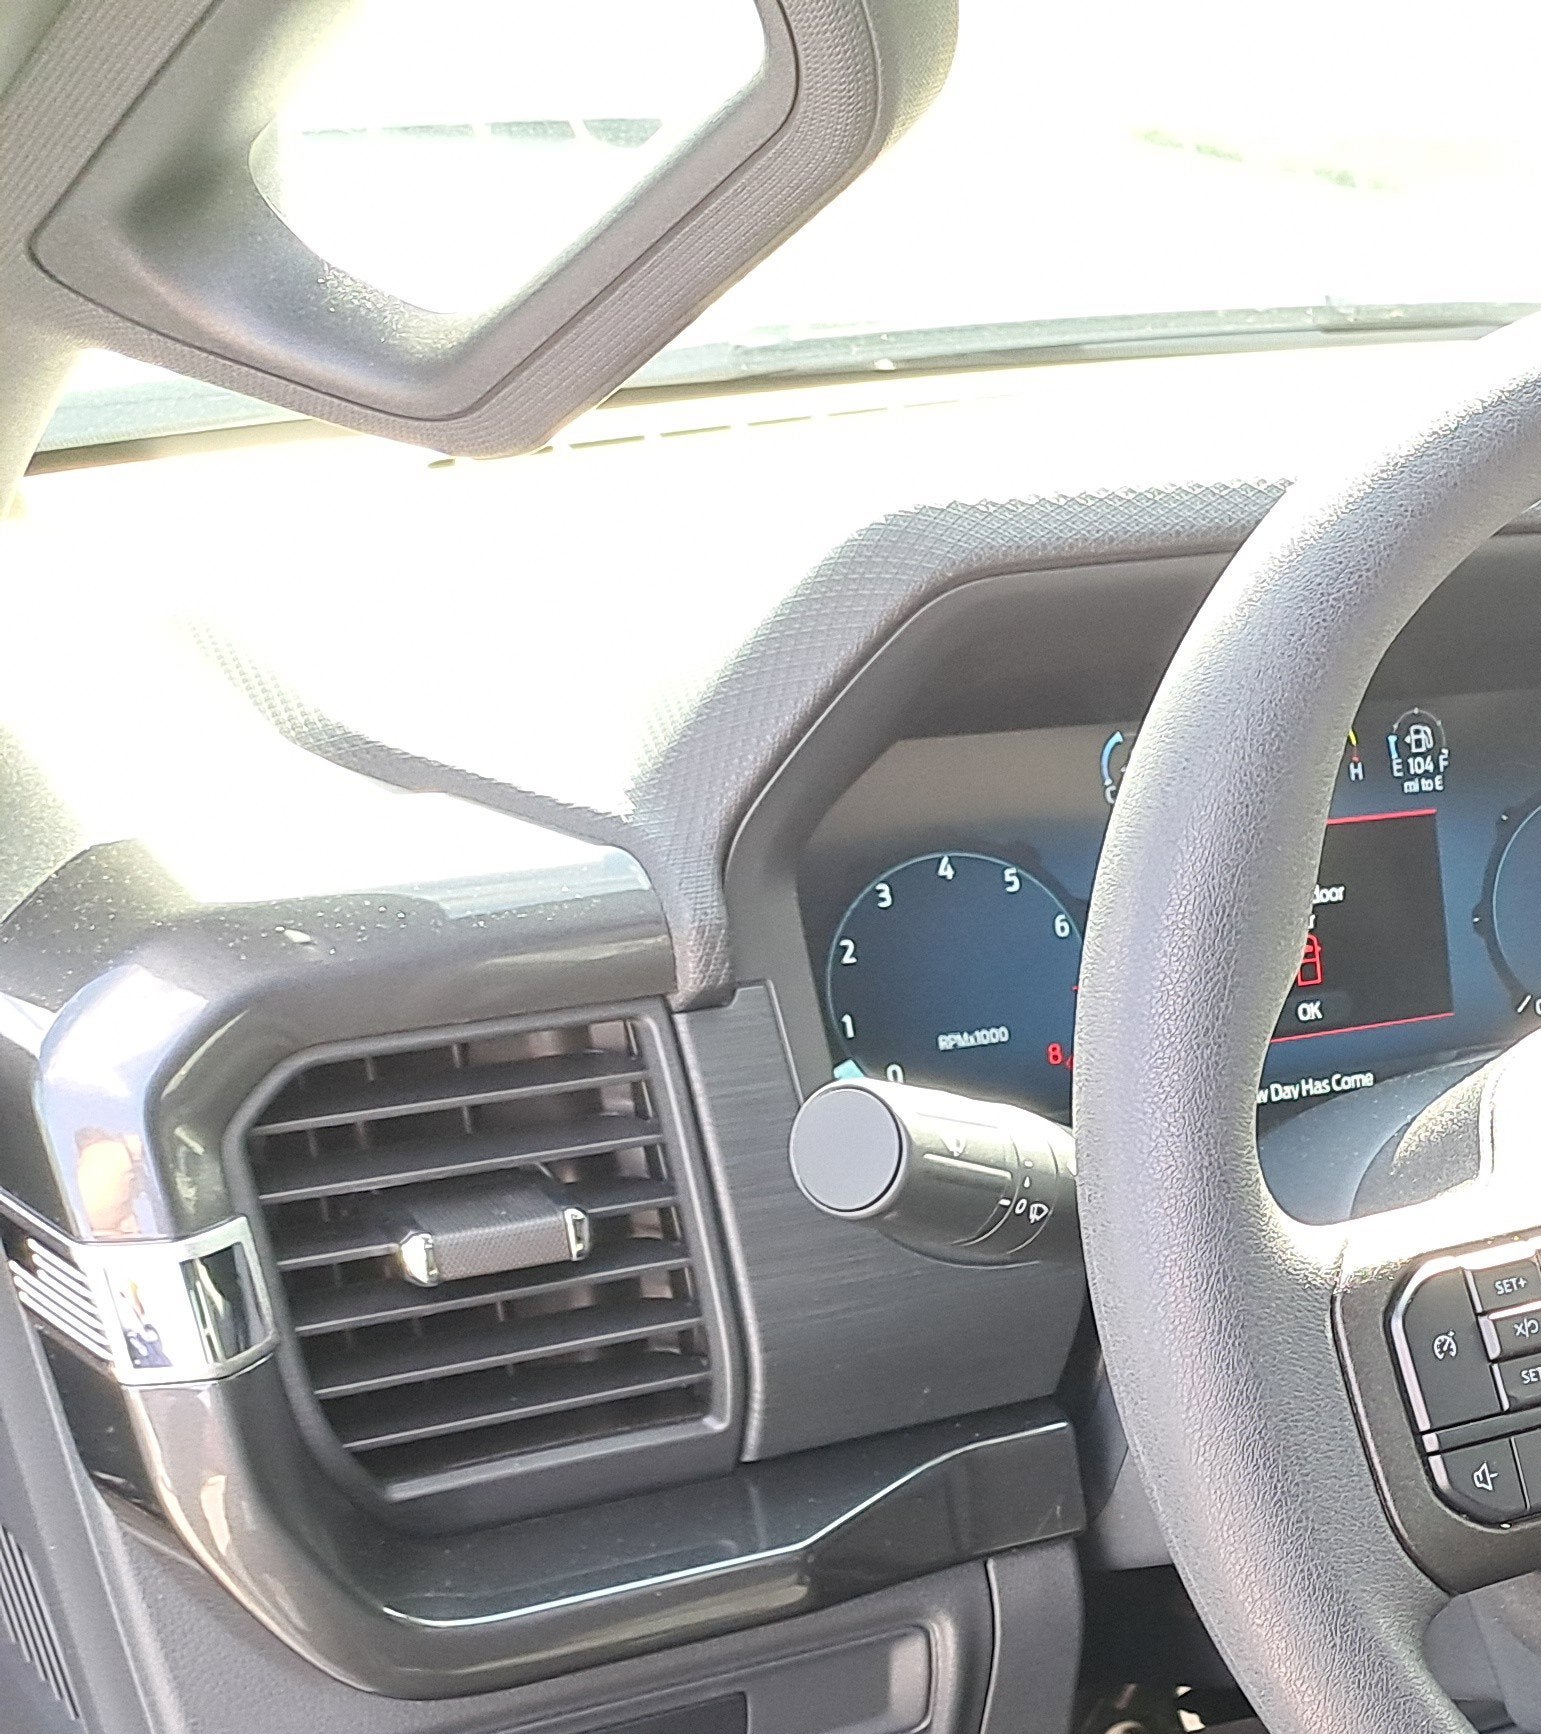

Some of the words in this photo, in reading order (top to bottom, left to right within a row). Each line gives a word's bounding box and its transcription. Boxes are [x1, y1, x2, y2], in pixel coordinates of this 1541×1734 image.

[1350, 762, 1363, 781] H
[1393, 758, 1403, 777] E
[1407, 755, 1434, 774] 104
[1438, 753, 1449, 772] F
[1421, 777, 1433, 791] to
[1434, 775, 1443, 790] E
[937, 855, 955, 880] 4
[1004, 867, 1021, 893] 5
[875, 882, 893, 908] 3
[1054, 914, 1070, 937] 6
[839, 939, 857, 965] 2
[1297, 1001, 1322, 1021] OK
[841, 1013, 855, 1038] 1
[937, 1026, 1010, 1051] RPMx1000
[1047, 1043, 1062, 1065] 8
[1270, 1081, 1299, 1102] Day
[1301, 1076, 1329, 1097] Has
[1331, 1070, 1374, 1090] Come
